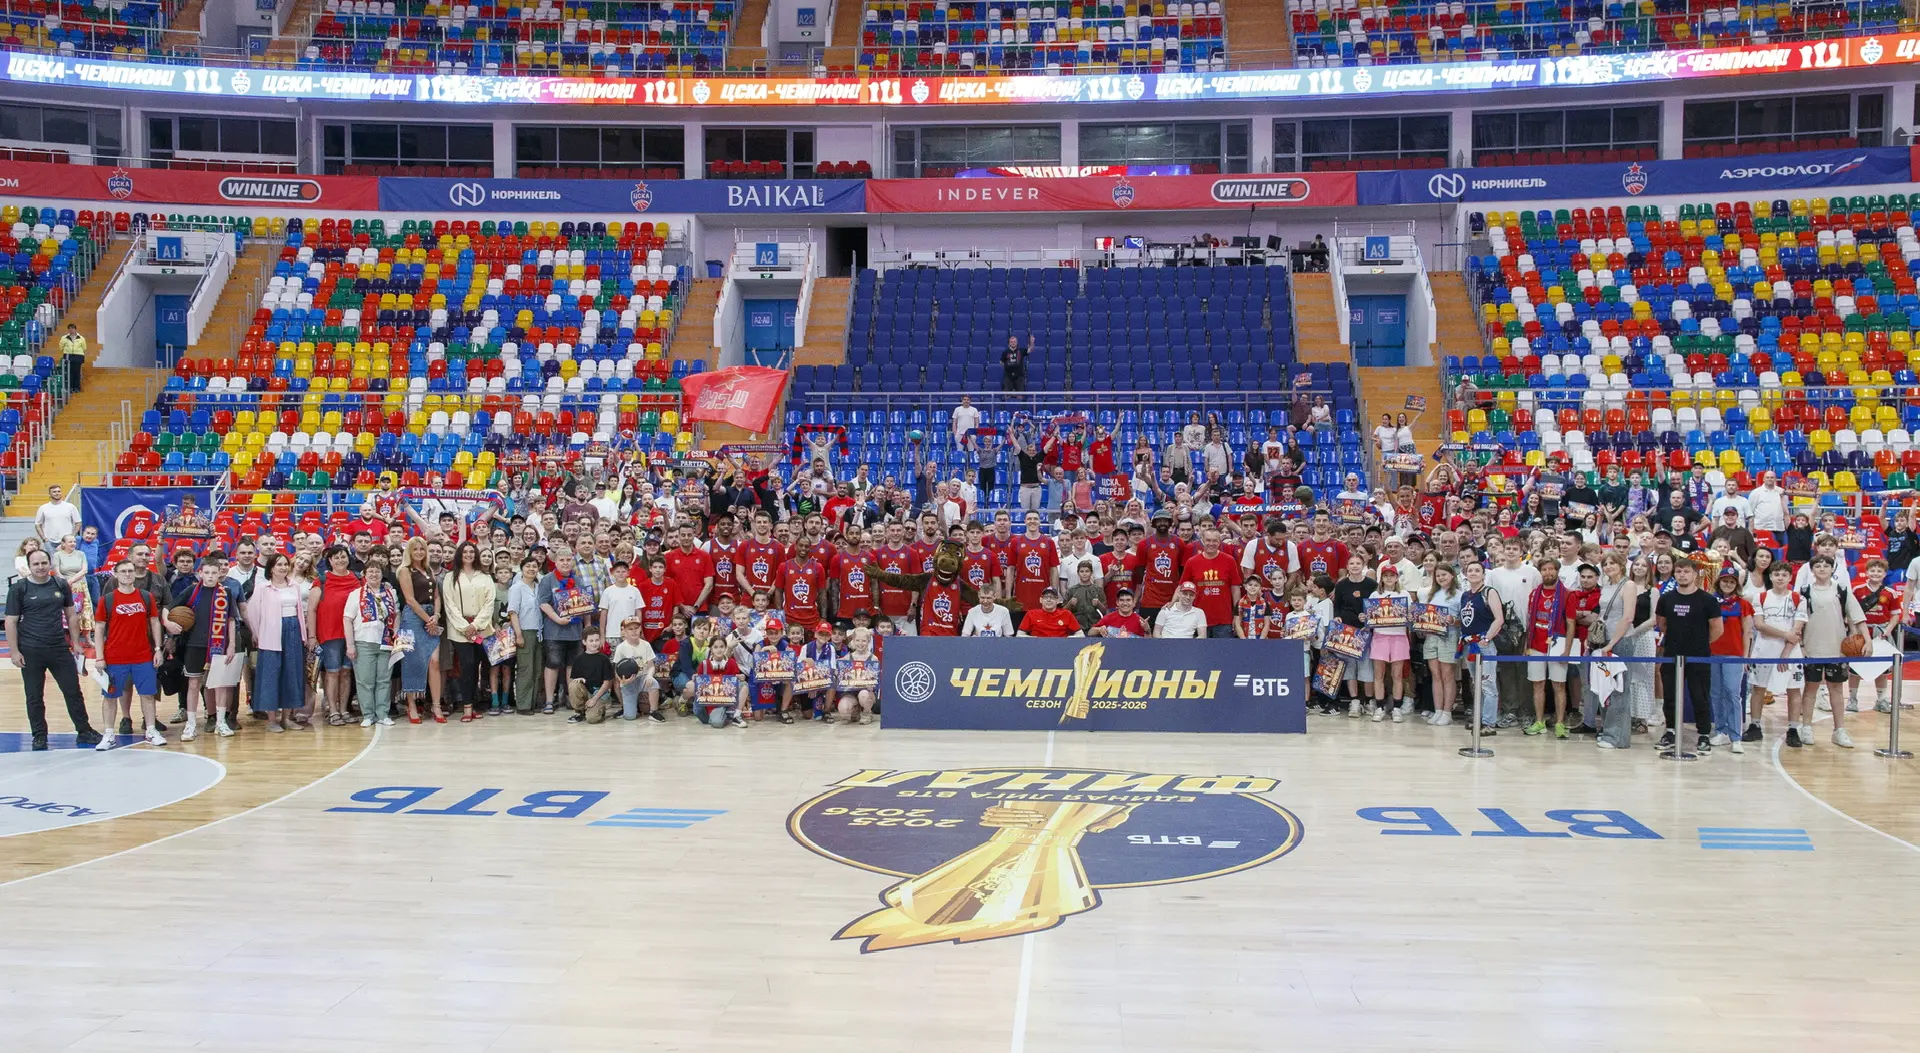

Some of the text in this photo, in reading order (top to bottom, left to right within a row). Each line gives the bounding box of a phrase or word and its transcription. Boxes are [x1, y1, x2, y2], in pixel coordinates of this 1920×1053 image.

[798, 14, 814, 25] A22
[7, 57, 175, 87] ЦСКА-ЧЕМПИОН!
[1382, 64, 1536, 88] ЦСКА-ЧЕМПИОН!
[262, 75, 412, 96] ЦСКА-ЧЕМПИОН!
[1155, 74, 1302, 97] ЦСКА-ЧЕМПИОН!
[720, 83, 862, 102] ЦСКА-ЧЕМПИОН!
[1719, 163, 1835, 180] АЭРОФЛОТ
[228, 182, 299, 198] WINLINE
[1219, 183, 1289, 197] WINLINE
[1472, 178, 1547, 190] НОРНИКЕЛЬ
[491, 190, 561, 200] НОРНИКЕЛЬ
[727, 185, 824, 207] BAIKAL
[938, 187, 1039, 201] INDEVER
[162, 245, 177, 258] A1
[760, 250, 774, 264] A2
[1369, 244, 1385, 257] A3
[412, 487, 431, 497] МЫ
[1236, 504, 1263, 513] ЦСКА
[761, 574, 767, 583] 4
[1164, 570, 1171, 578] 17
[858, 584, 864, 592] 6
[942, 613, 953, 622] 25
[950, 668, 1222, 700] ЧЕМПИОНЫ
[1252, 679, 1290, 697] ВТБ
[1026, 700, 1148, 710] СЕЗОН 2025-2026
[826, 768, 1281, 795] ФИНАЛ
[322, 786, 611, 818] ВТБ
[896, 790, 1197, 803] ЕДИНАЯ ЛИГА ВТБ
[821, 807, 935, 817] 2026
[848, 817, 964, 828] 2025
[1356, 806, 1665, 840] ВТБ
[1126, 834, 1203, 845] ВТБ
